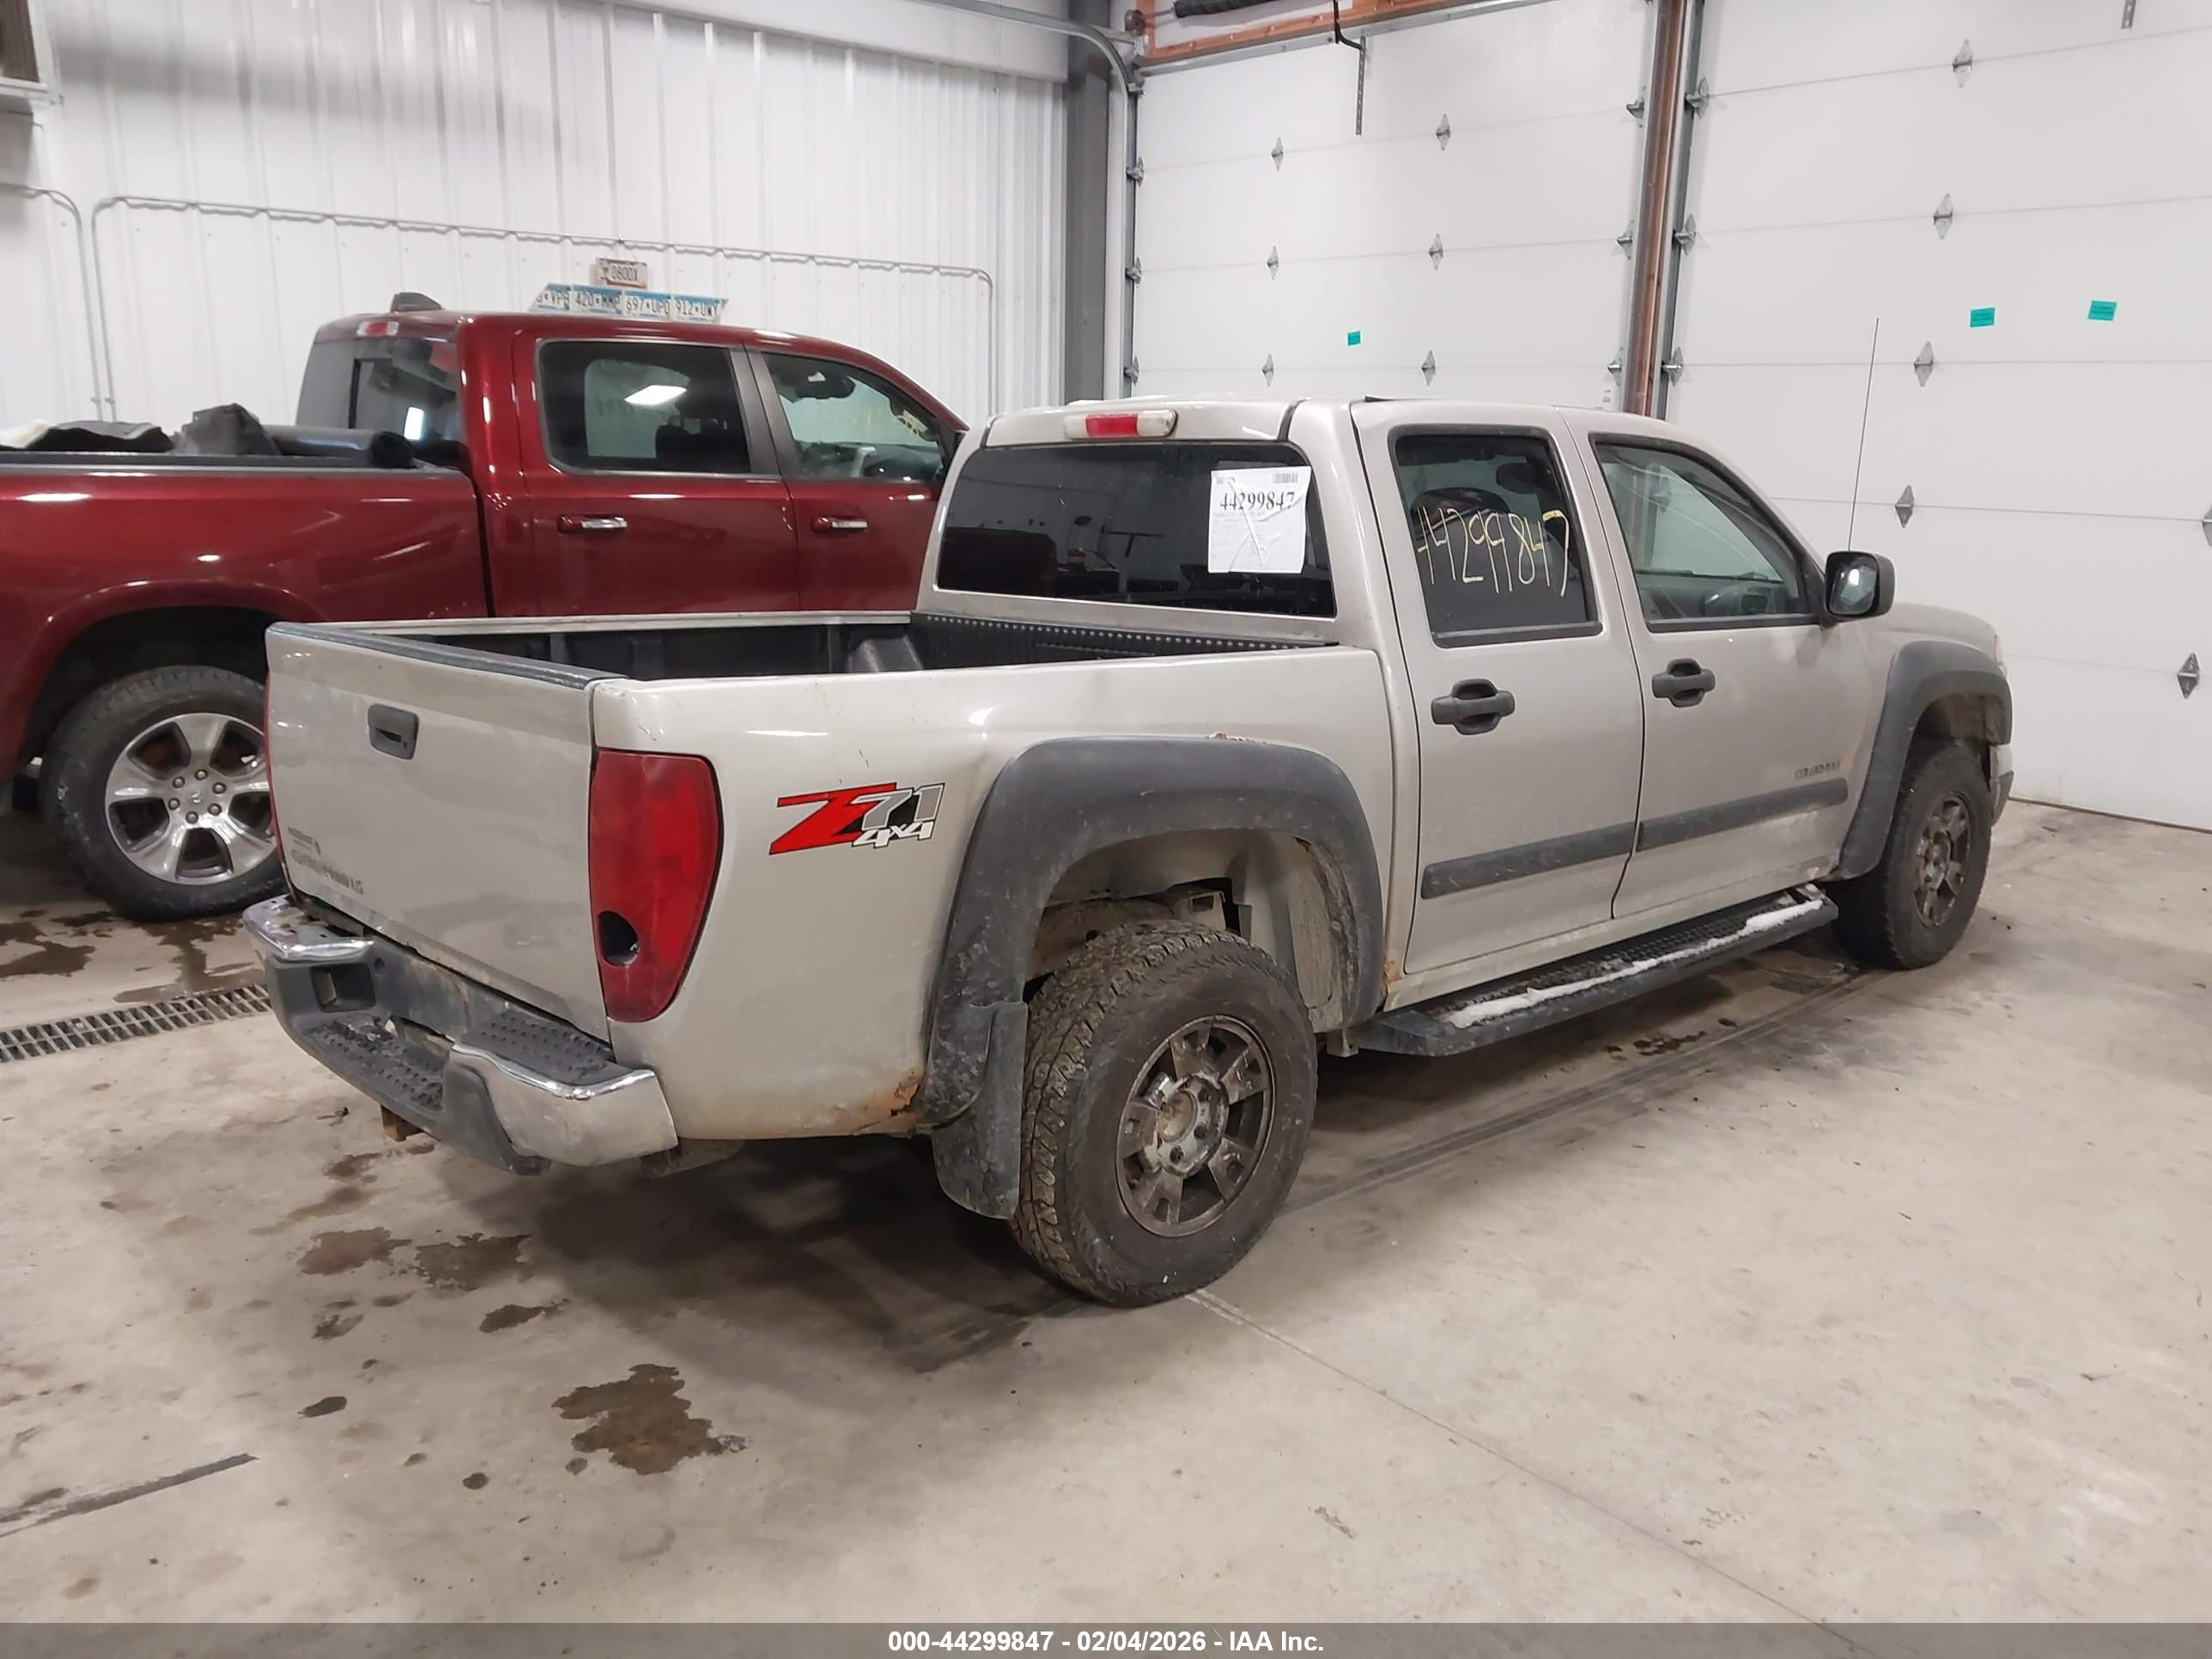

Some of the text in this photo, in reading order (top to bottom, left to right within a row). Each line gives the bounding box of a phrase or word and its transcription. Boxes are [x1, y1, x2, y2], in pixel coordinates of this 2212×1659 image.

[1219, 490, 1296, 511] 44299847
[1416, 505, 1571, 598] 44299847
[769, 781, 945, 855] Z71
